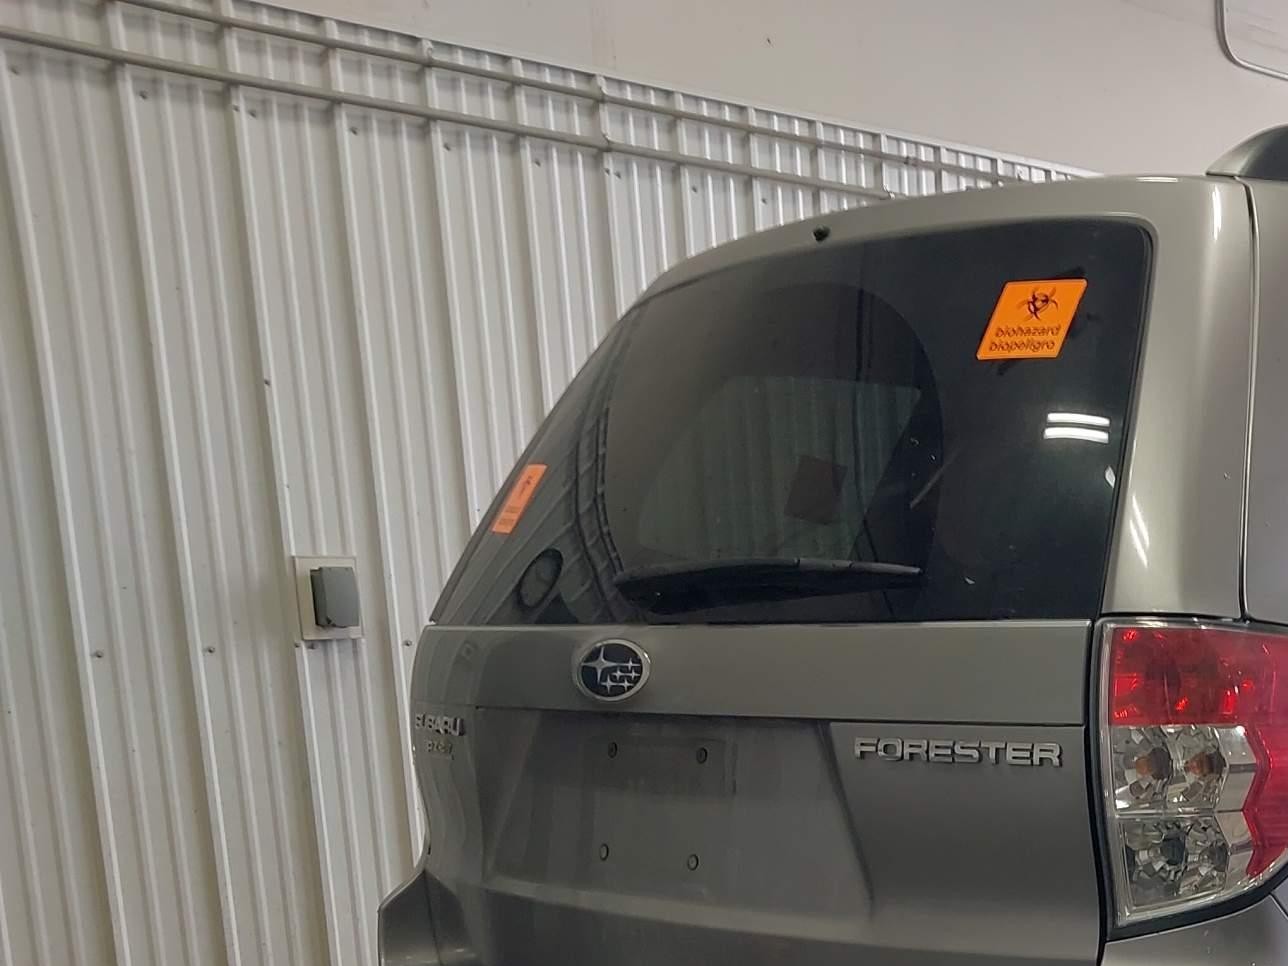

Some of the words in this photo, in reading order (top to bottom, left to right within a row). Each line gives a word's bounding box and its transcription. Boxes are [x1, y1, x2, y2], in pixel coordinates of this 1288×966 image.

[995, 324, 1061, 337] biohazard
[988, 338, 1056, 352] biopeligro
[853, 737, 1062, 767] FORESTER
